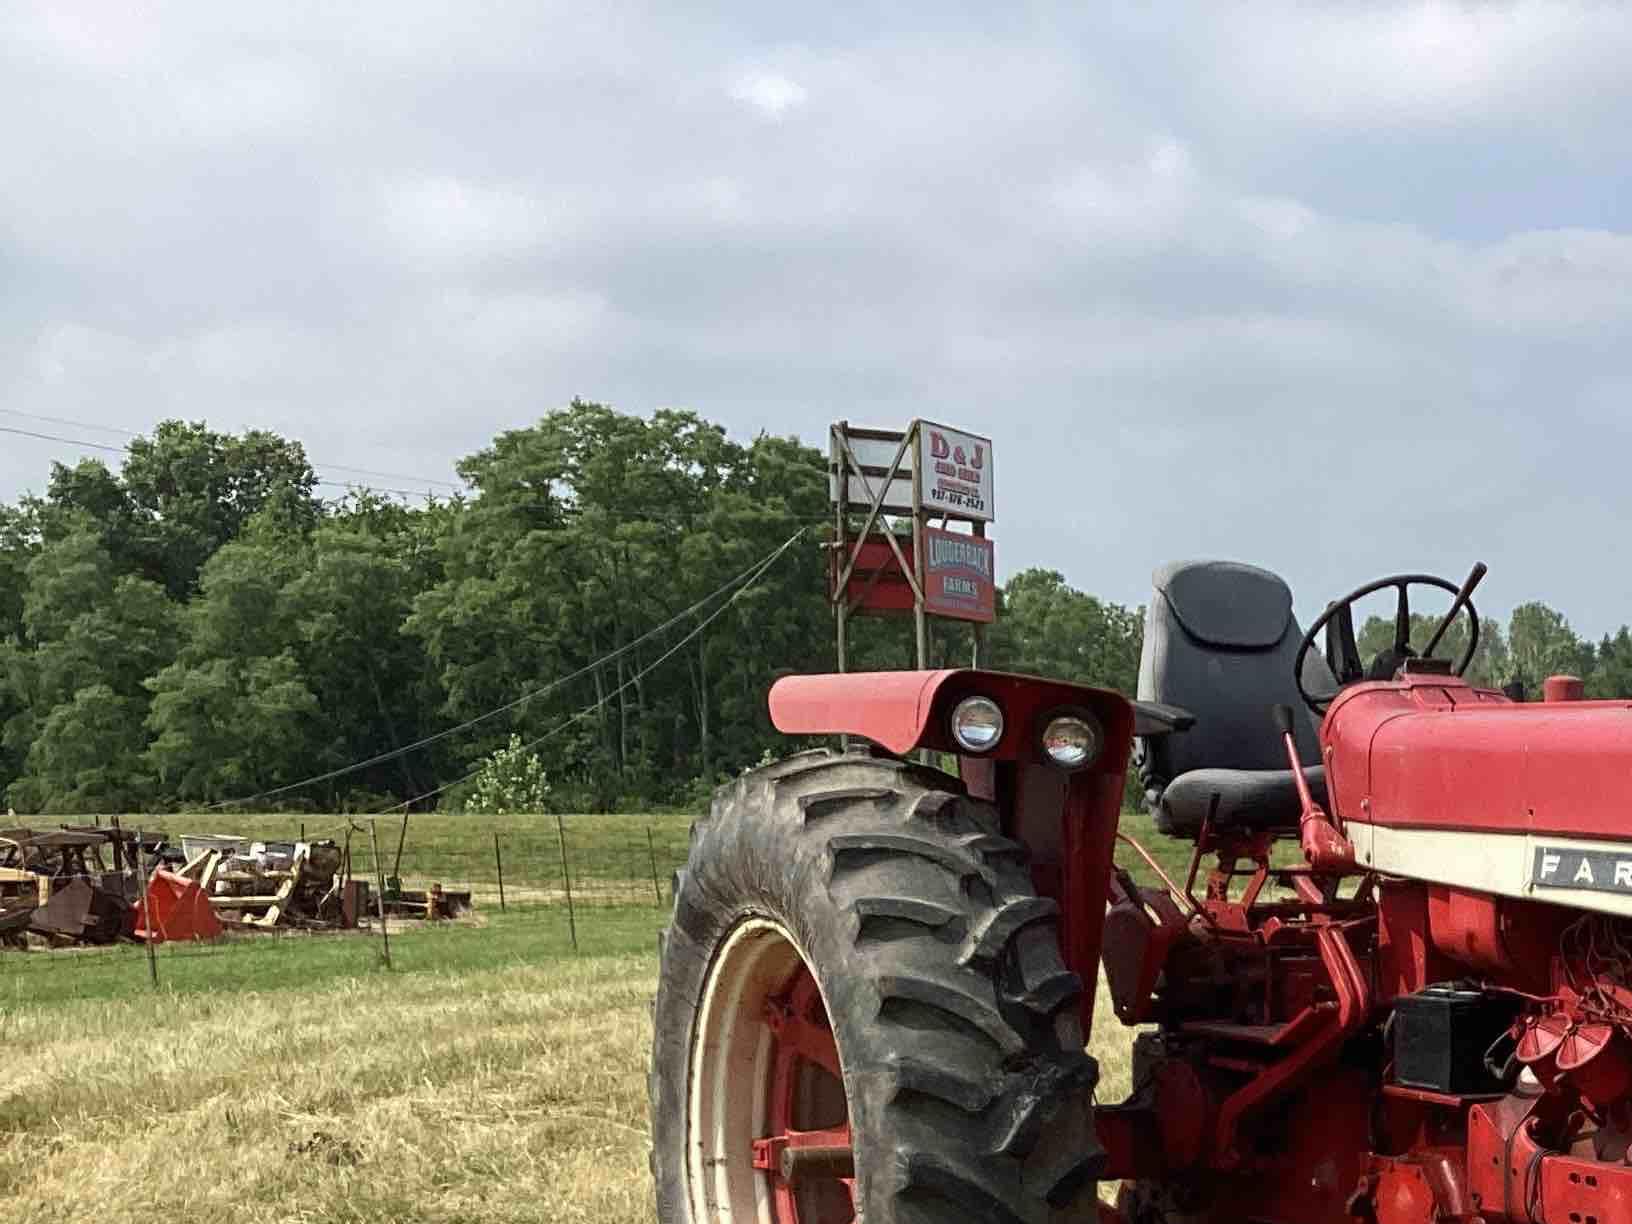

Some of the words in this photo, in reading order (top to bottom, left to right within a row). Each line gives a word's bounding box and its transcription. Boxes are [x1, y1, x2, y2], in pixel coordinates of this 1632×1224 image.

[929, 431, 950, 459] D
[953, 446, 967, 466] &
[971, 444, 984, 470] J
